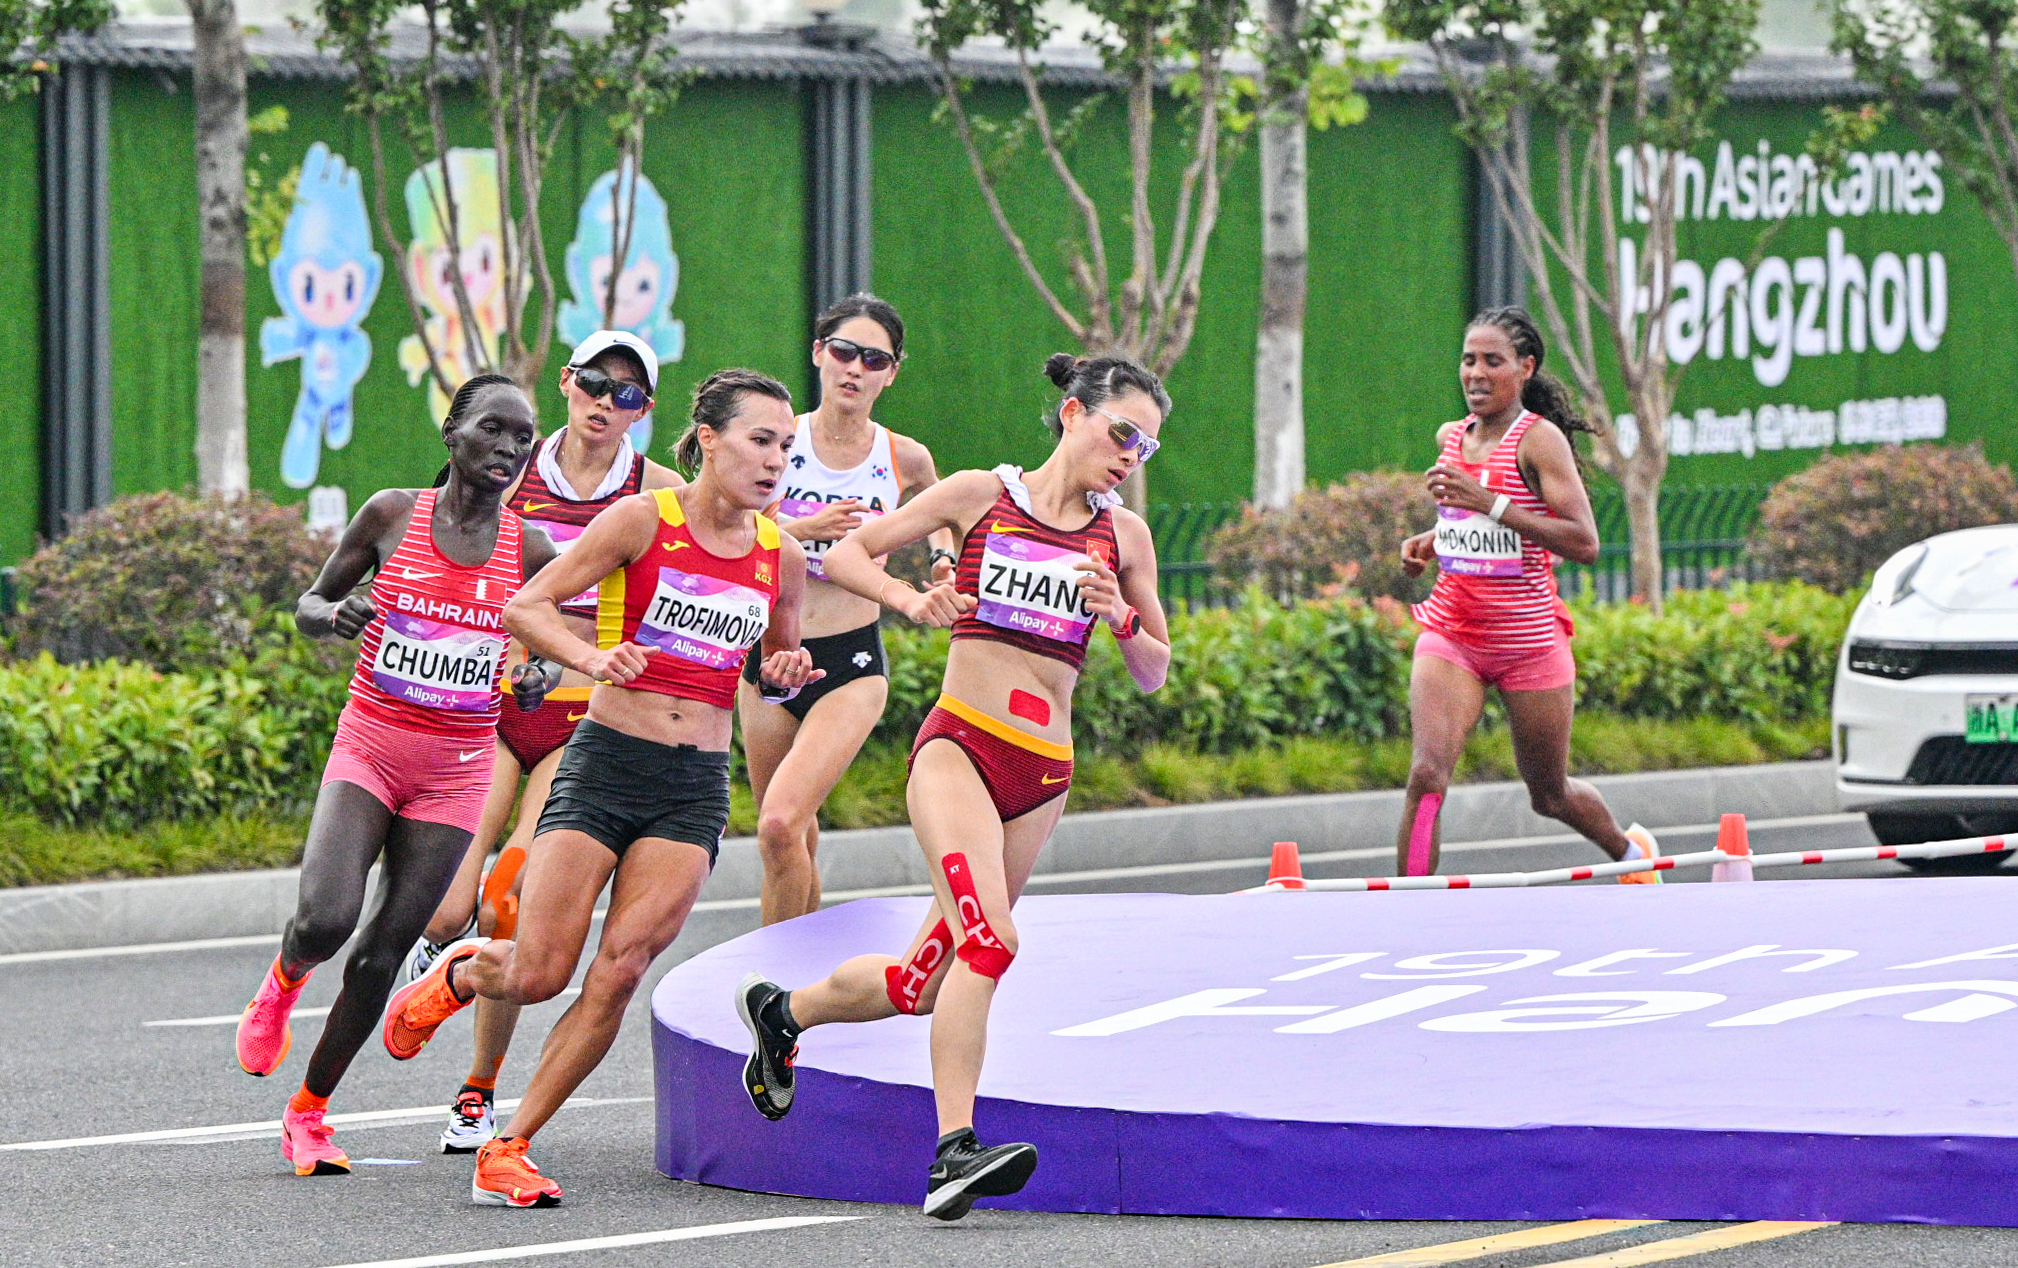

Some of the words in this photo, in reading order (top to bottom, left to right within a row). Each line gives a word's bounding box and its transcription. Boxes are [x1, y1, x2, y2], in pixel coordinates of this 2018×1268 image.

[1615, 143, 1706, 224] 19h
[1707, 138, 1819, 221] Asian
[1619, 226, 1948, 387] Hangzhou
[784, 486, 884, 513] KOA
[754, 572, 773, 586] KGZ
[396, 592, 499, 630] BAHRAIN
[653, 596, 763, 646] TROFIMOVA
[748, 605, 761, 618] 68
[382, 641, 491, 686] CHUMBA
[476, 646, 490, 657] 51
[958, 894, 1003, 949] CH
[902, 938, 944, 1009] CH
[1269, 944, 1860, 981] 19th
